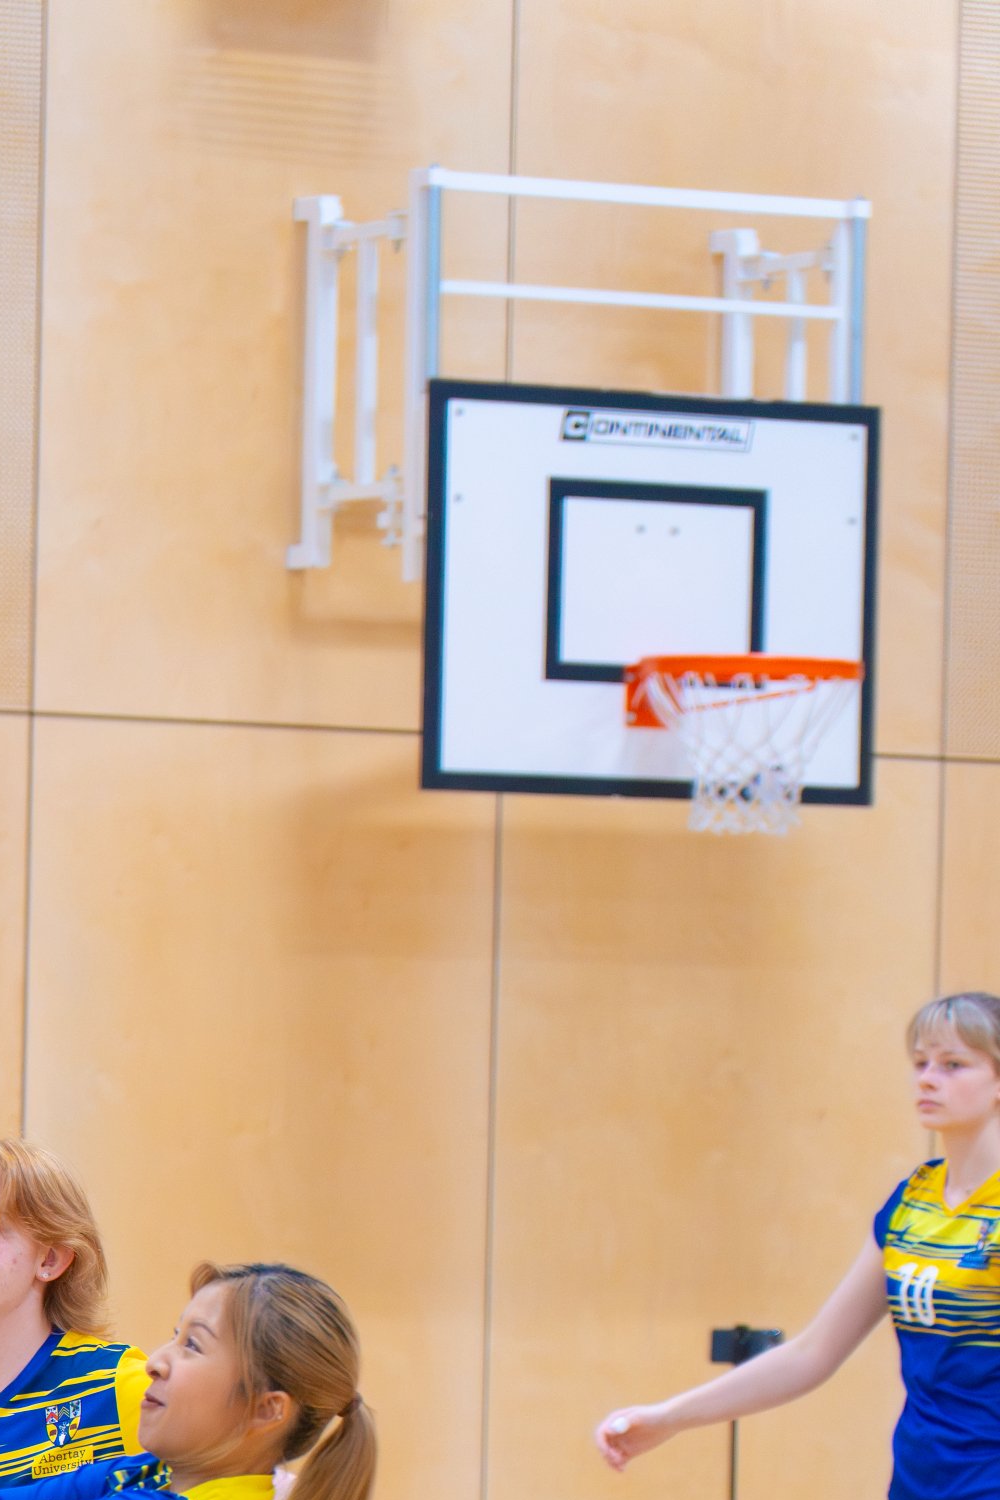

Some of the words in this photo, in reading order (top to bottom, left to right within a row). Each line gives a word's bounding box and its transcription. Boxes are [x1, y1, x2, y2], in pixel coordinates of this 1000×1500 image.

[562, 411, 743, 442] CONTINENTAL
[898, 1262, 938, 1327] 10
[39, 1450, 86, 1464] Abertay
